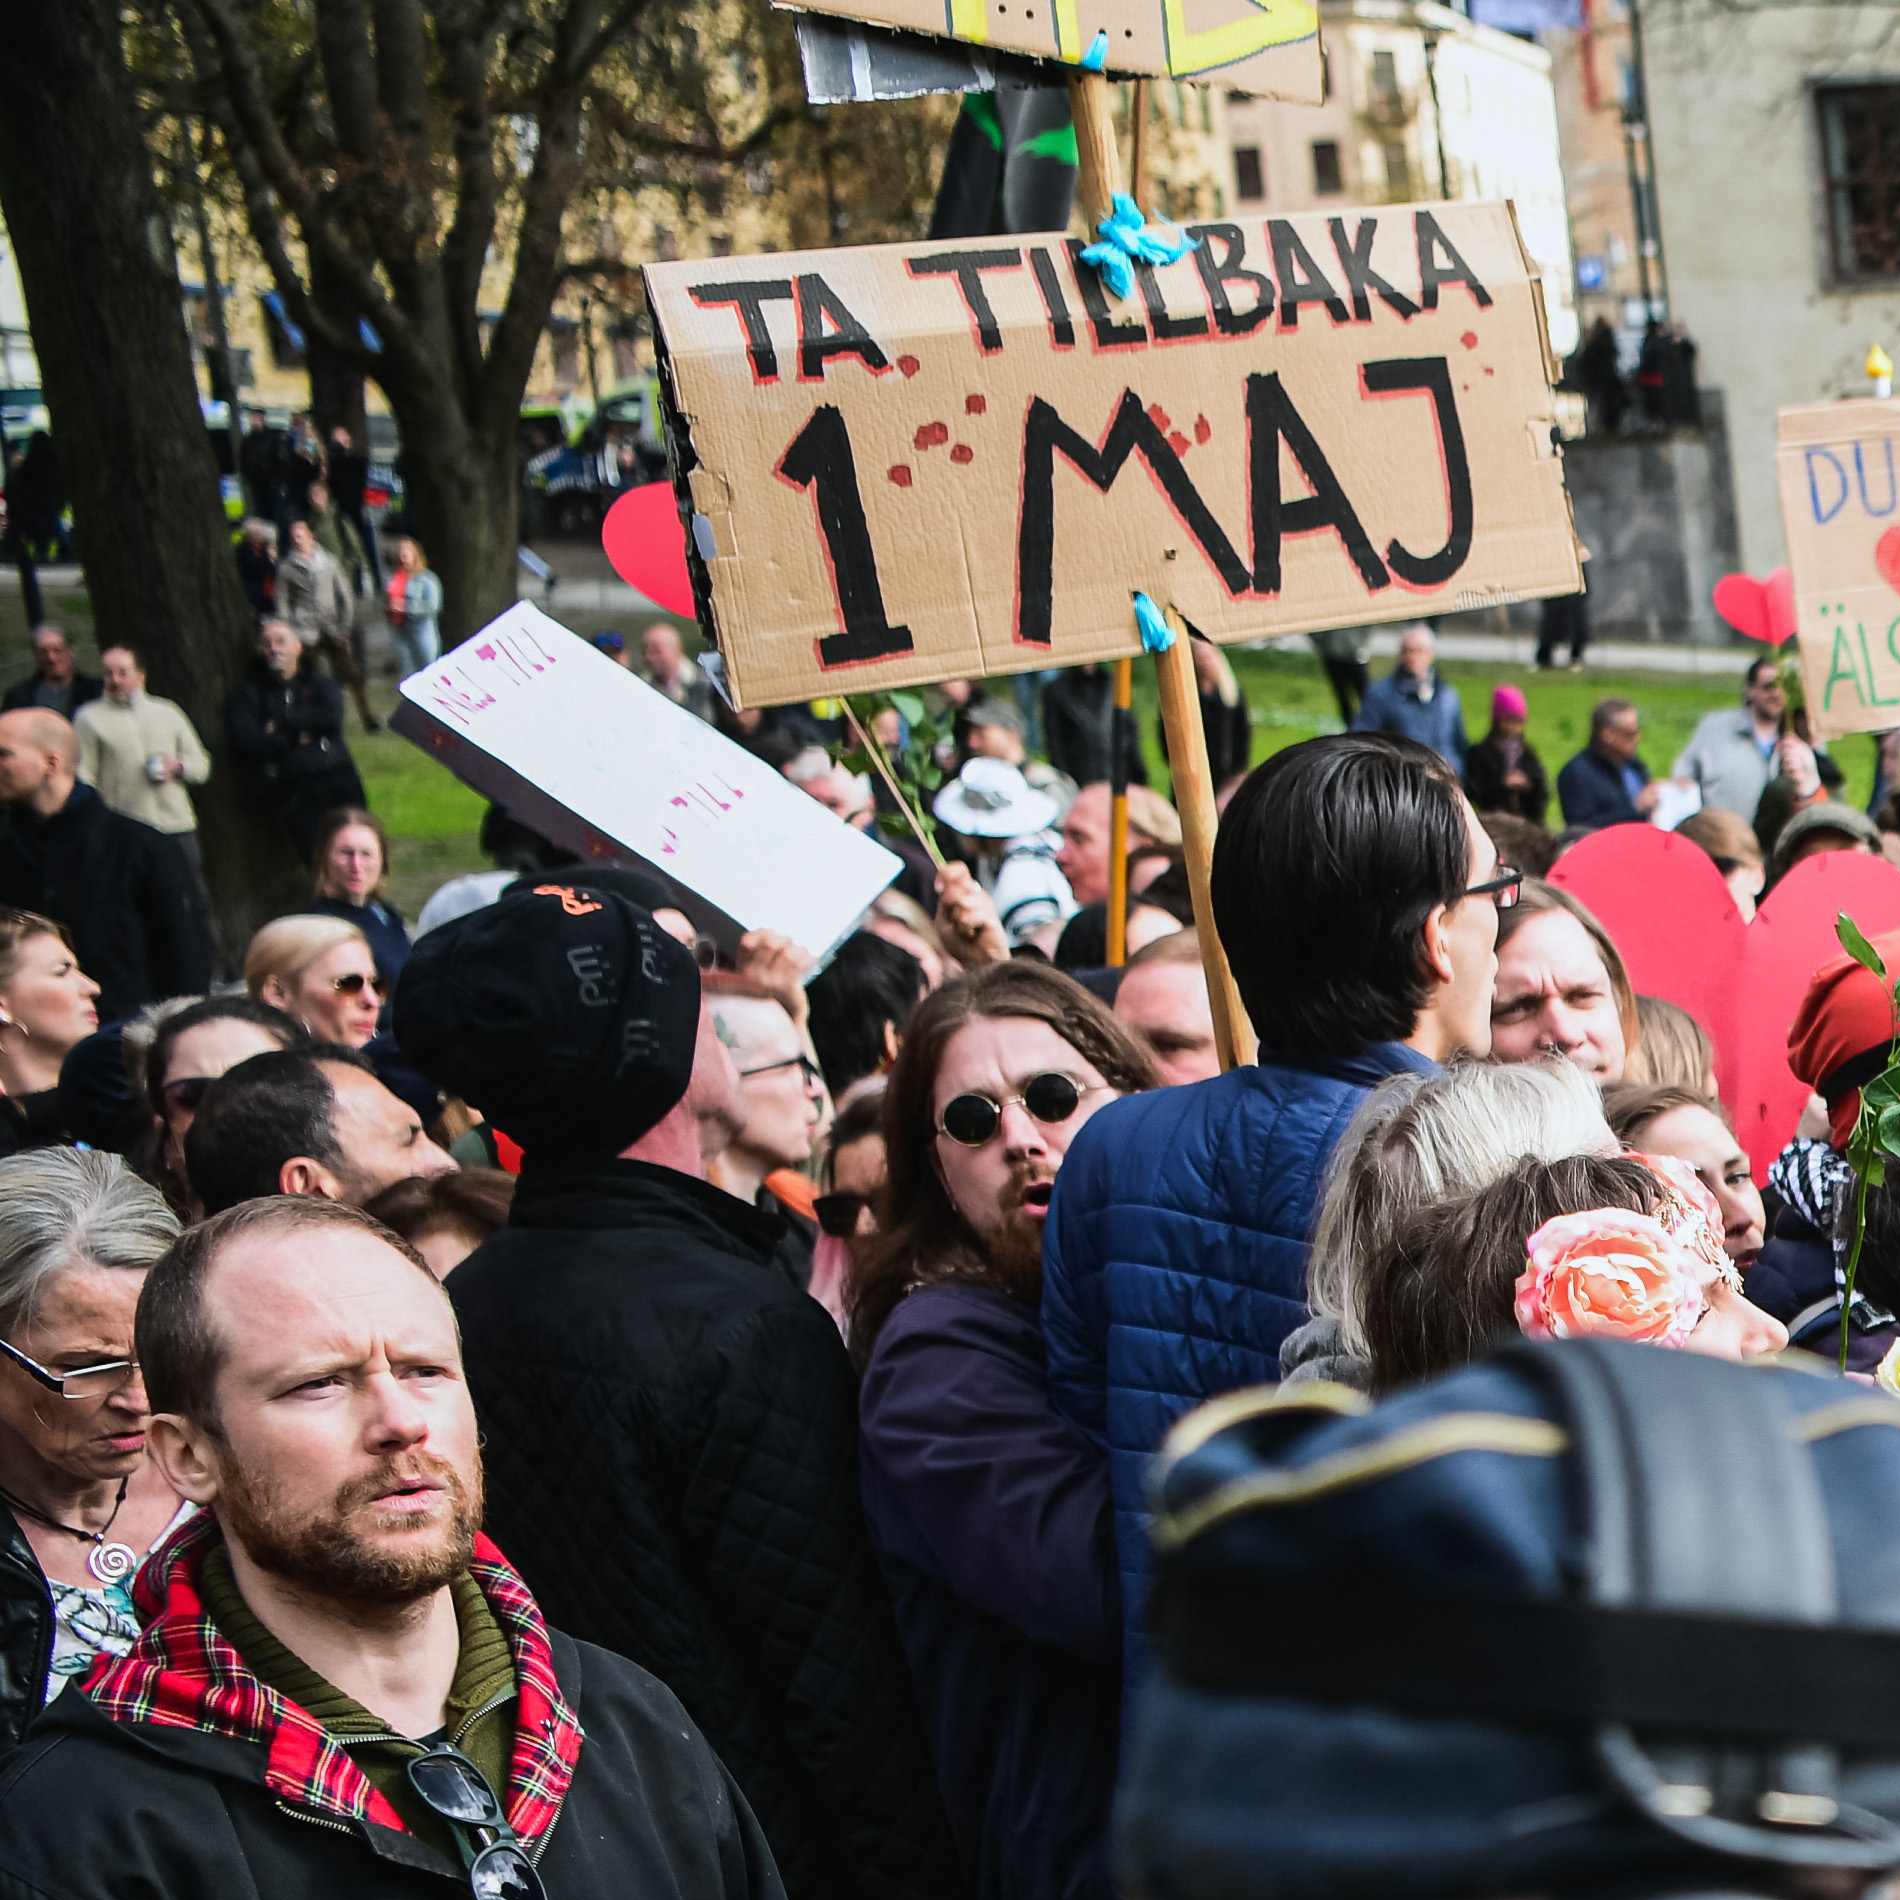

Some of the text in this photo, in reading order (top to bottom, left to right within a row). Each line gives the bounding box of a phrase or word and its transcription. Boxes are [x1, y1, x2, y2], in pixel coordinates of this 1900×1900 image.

[689, 210, 1492, 383] TA TILLBAKA
[775, 355, 1475, 670] 1 MAJ
[1804, 438, 1897, 525] DU
